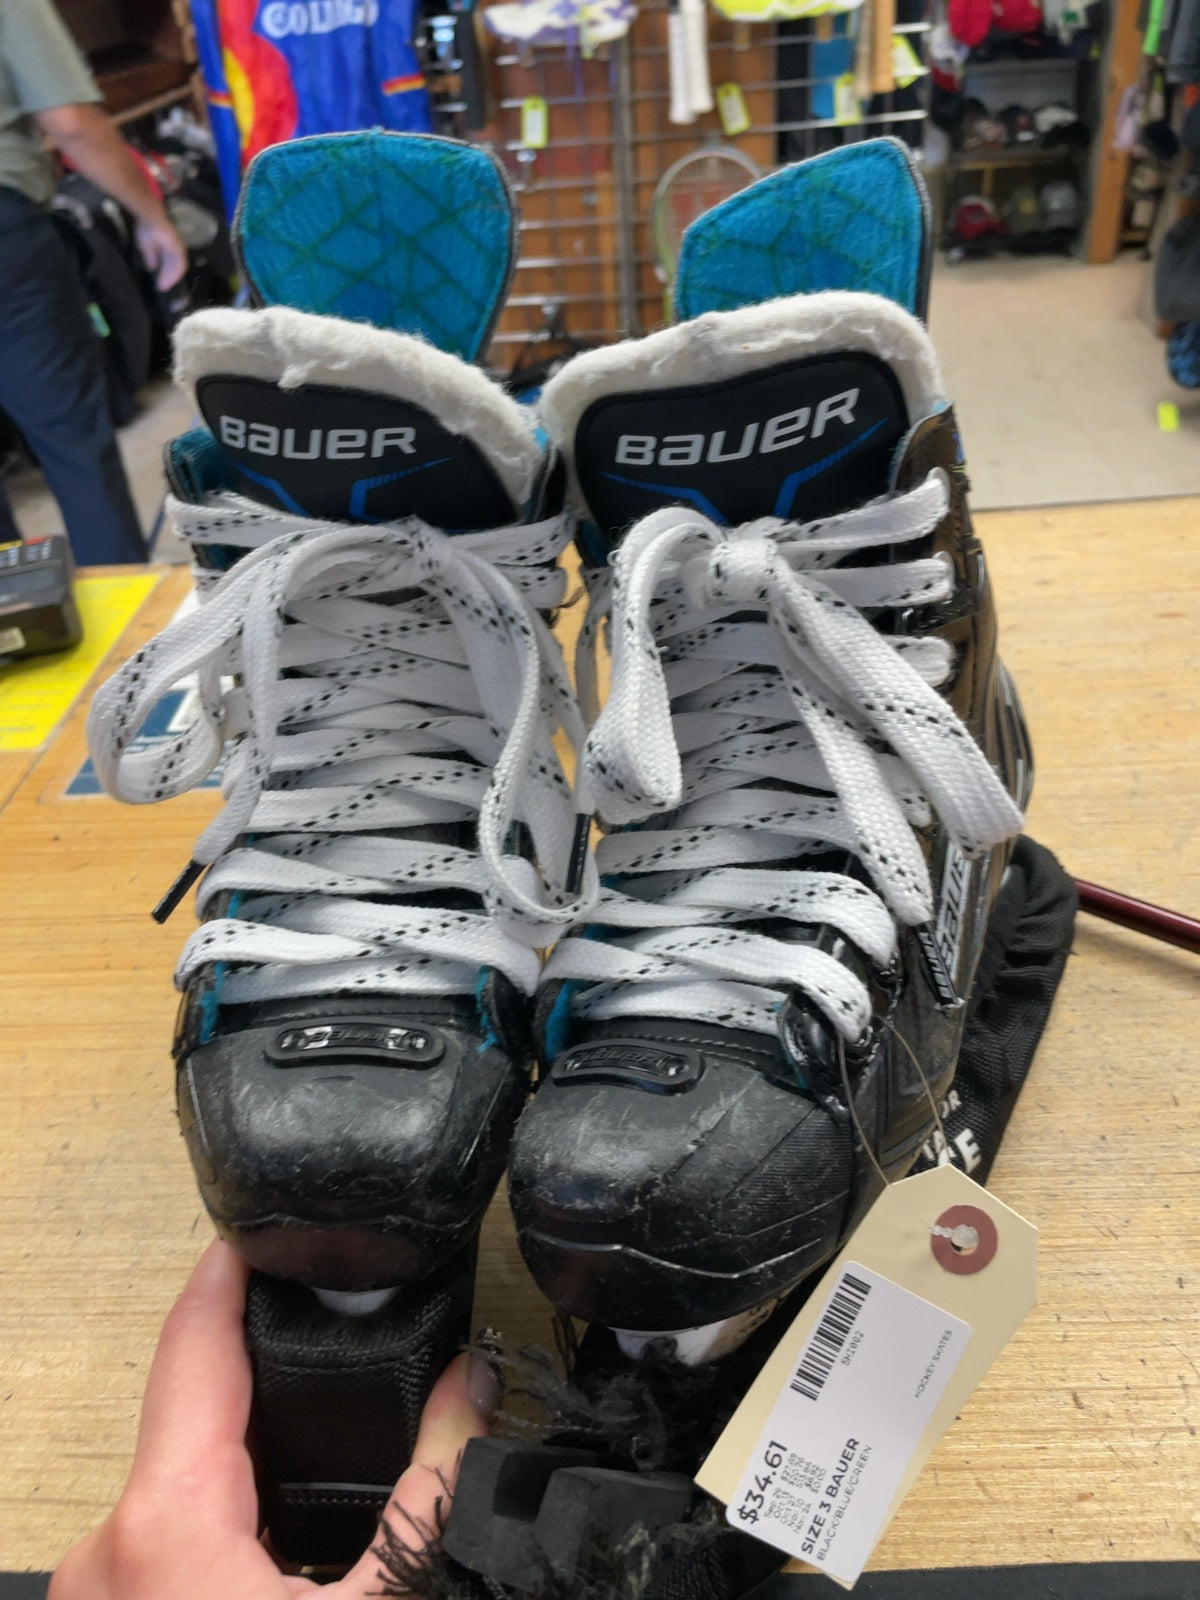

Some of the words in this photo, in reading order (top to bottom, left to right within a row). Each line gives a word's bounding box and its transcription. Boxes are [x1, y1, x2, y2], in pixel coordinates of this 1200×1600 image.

[219, 414, 417, 460] BAUER
[614, 388, 861, 466] BAUER
[914, 1362, 935, 1398] HOCKEY
[932, 1330, 952, 1361] SKATES
[737, 1440, 788, 1524] $34.61
[801, 1515, 826, 1555] SIZE
[819, 1501, 831, 1513] 3
[825, 1438, 859, 1498] BAUER
[815, 1445, 872, 1561] BLACK/BLUE/GREEN
